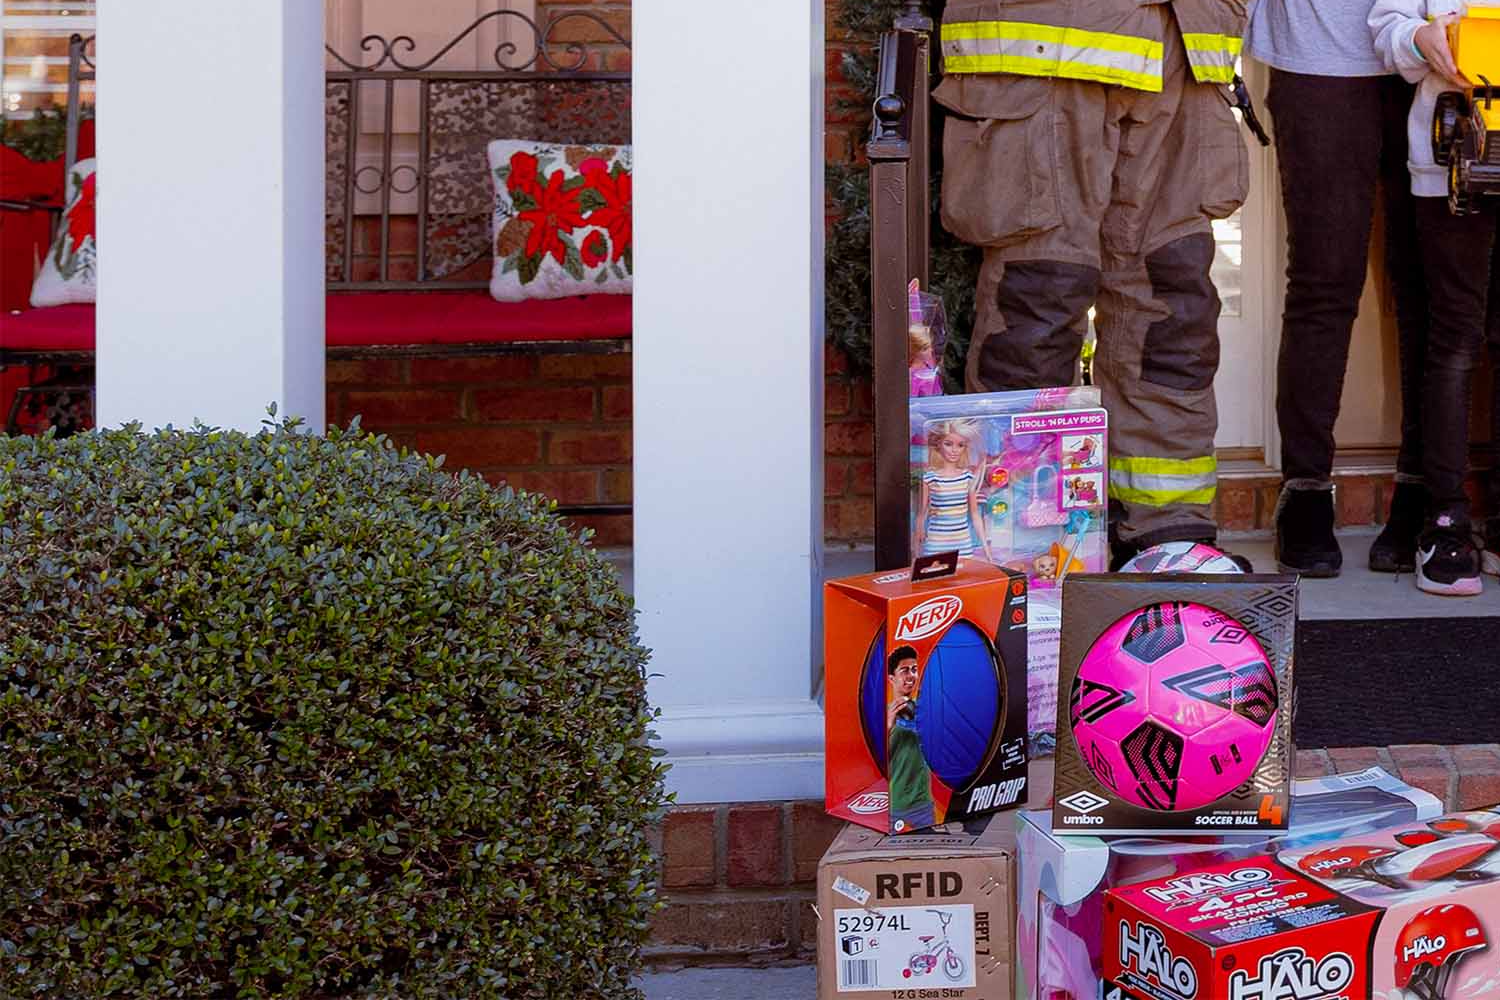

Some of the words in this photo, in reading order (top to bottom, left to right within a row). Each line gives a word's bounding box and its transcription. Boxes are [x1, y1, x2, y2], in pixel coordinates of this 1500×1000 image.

[1016, 420, 1047, 430] STROLL
[1058, 417, 1078, 426] PLAY
[1080, 415, 1102, 425] PUPS
[899, 597, 960, 639] NERF
[966, 785, 997, 813] PRO
[996, 777, 1027, 807] GRIP
[1063, 814, 1104, 825] umbro
[1195, 815, 1234, 825] SOCCER
[1234, 815, 1259, 825] BALL
[1258, 795, 1282, 825] 4
[1309, 856, 1352, 872] HALO
[876, 871, 963, 900] RFID
[1146, 867, 1272, 903] HALO
[1198, 896, 1233, 912] 4
[1234, 887, 1279, 902] PC
[1188, 892, 1309, 924] SKATEBOARD
[838, 914, 911, 934] 52974L
[976, 912, 990, 945] DEPT.
[1121, 922, 1196, 995] HALO
[1403, 934, 1446, 963] HALO
[1230, 948, 1355, 1000] HALO
[892, 989, 905, 999] 12
[907, 989, 917, 999] G
[919, 988, 940, 999] Sea
[943, 988, 965, 999] Star
